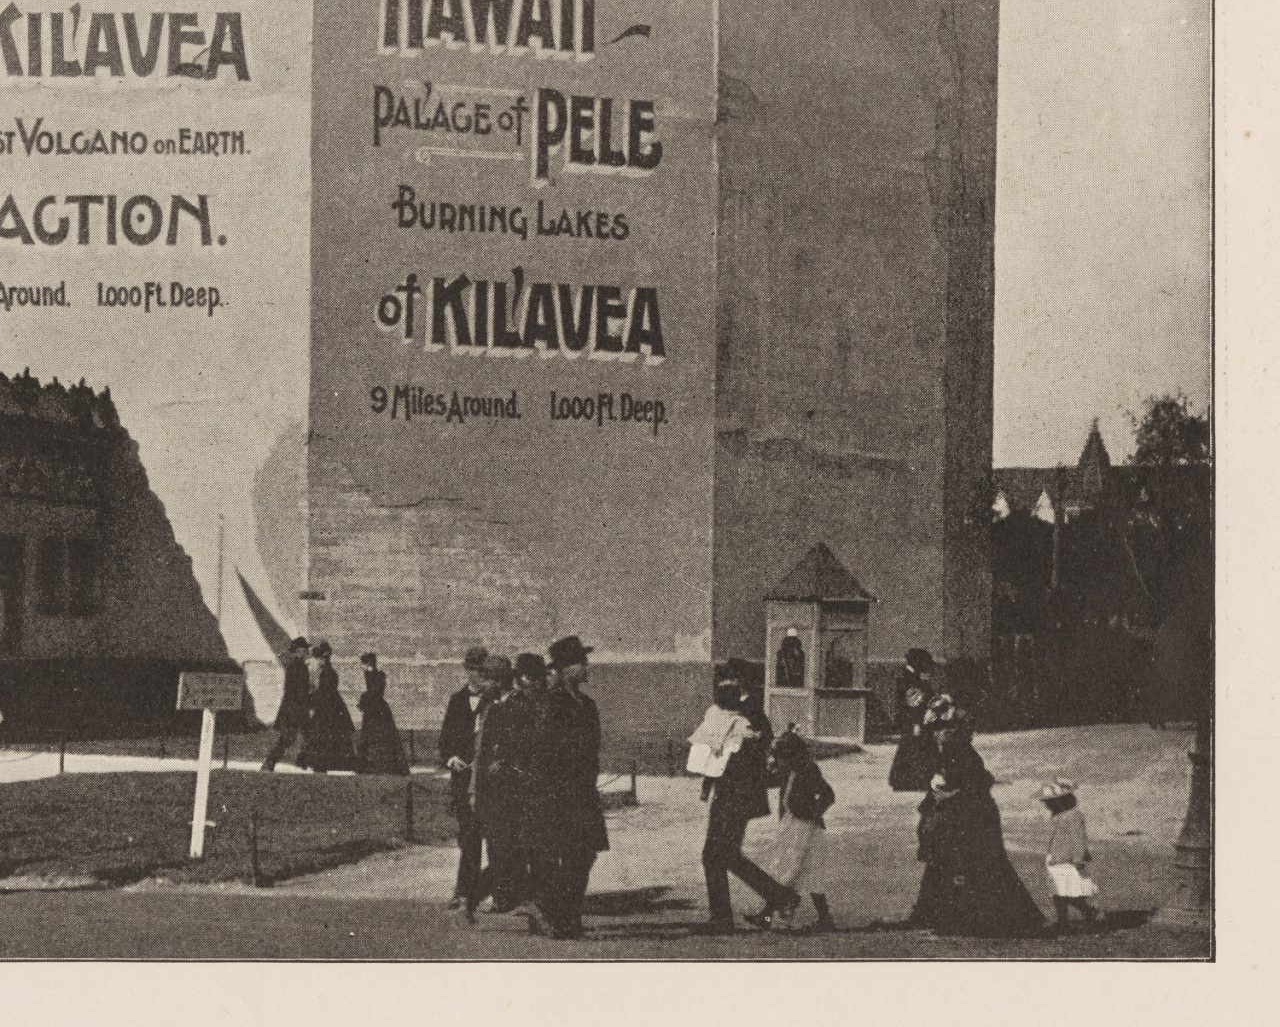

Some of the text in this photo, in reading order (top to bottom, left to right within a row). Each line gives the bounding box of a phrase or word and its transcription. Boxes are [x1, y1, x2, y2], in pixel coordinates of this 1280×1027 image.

[16, 117, 149, 157] VOLCANO
[152, 138, 178, 156] on
[177, 127, 252, 157] EARTH.
[536, 87, 663, 179] PELE
[392, 184, 631, 241] BURNING LAKES
[370, 384, 521, 423] 9 Miles Around.
